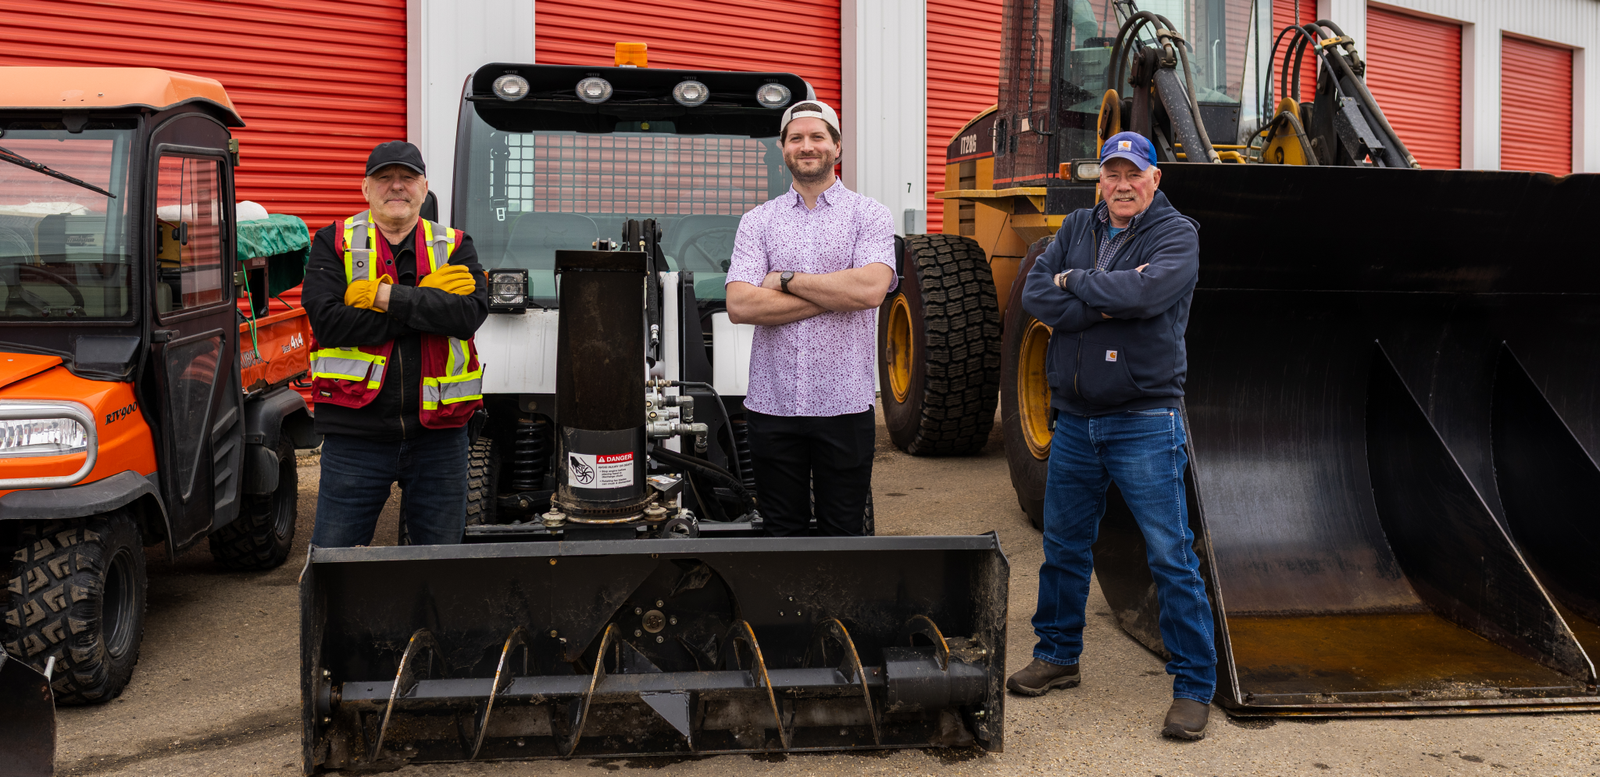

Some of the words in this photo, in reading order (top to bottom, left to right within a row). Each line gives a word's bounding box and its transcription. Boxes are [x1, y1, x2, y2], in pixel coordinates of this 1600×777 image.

[907, 182, 912, 193] 7
[291, 332, 304, 349] 4x4
[606, 454, 632, 462] DANGER
